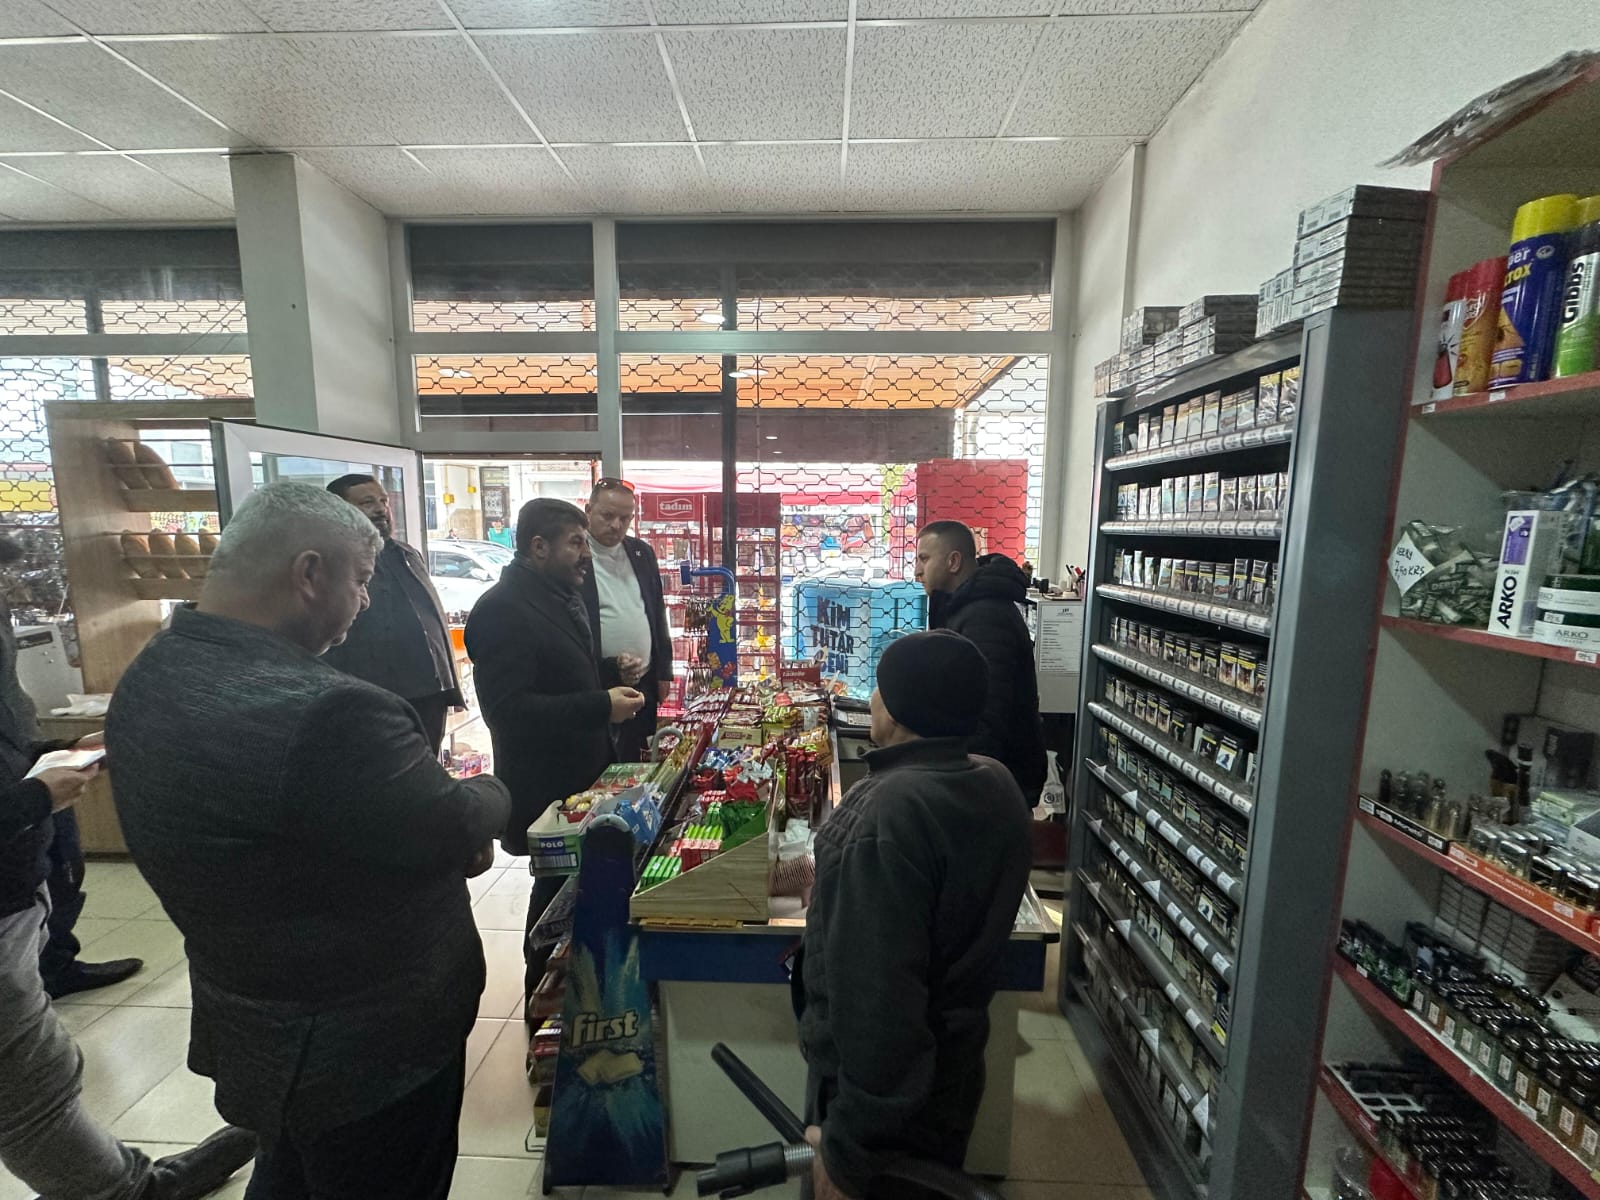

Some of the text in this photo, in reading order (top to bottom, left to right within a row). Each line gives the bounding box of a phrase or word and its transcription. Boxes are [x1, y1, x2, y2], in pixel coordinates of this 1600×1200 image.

[1562, 262, 1585, 324] Gibbs
[1497, 576, 1518, 630] ARKO
[811, 624, 855, 655] TUTAR
[1555, 629, 1589, 639] ARKO
[572, 1010, 638, 1047] first
